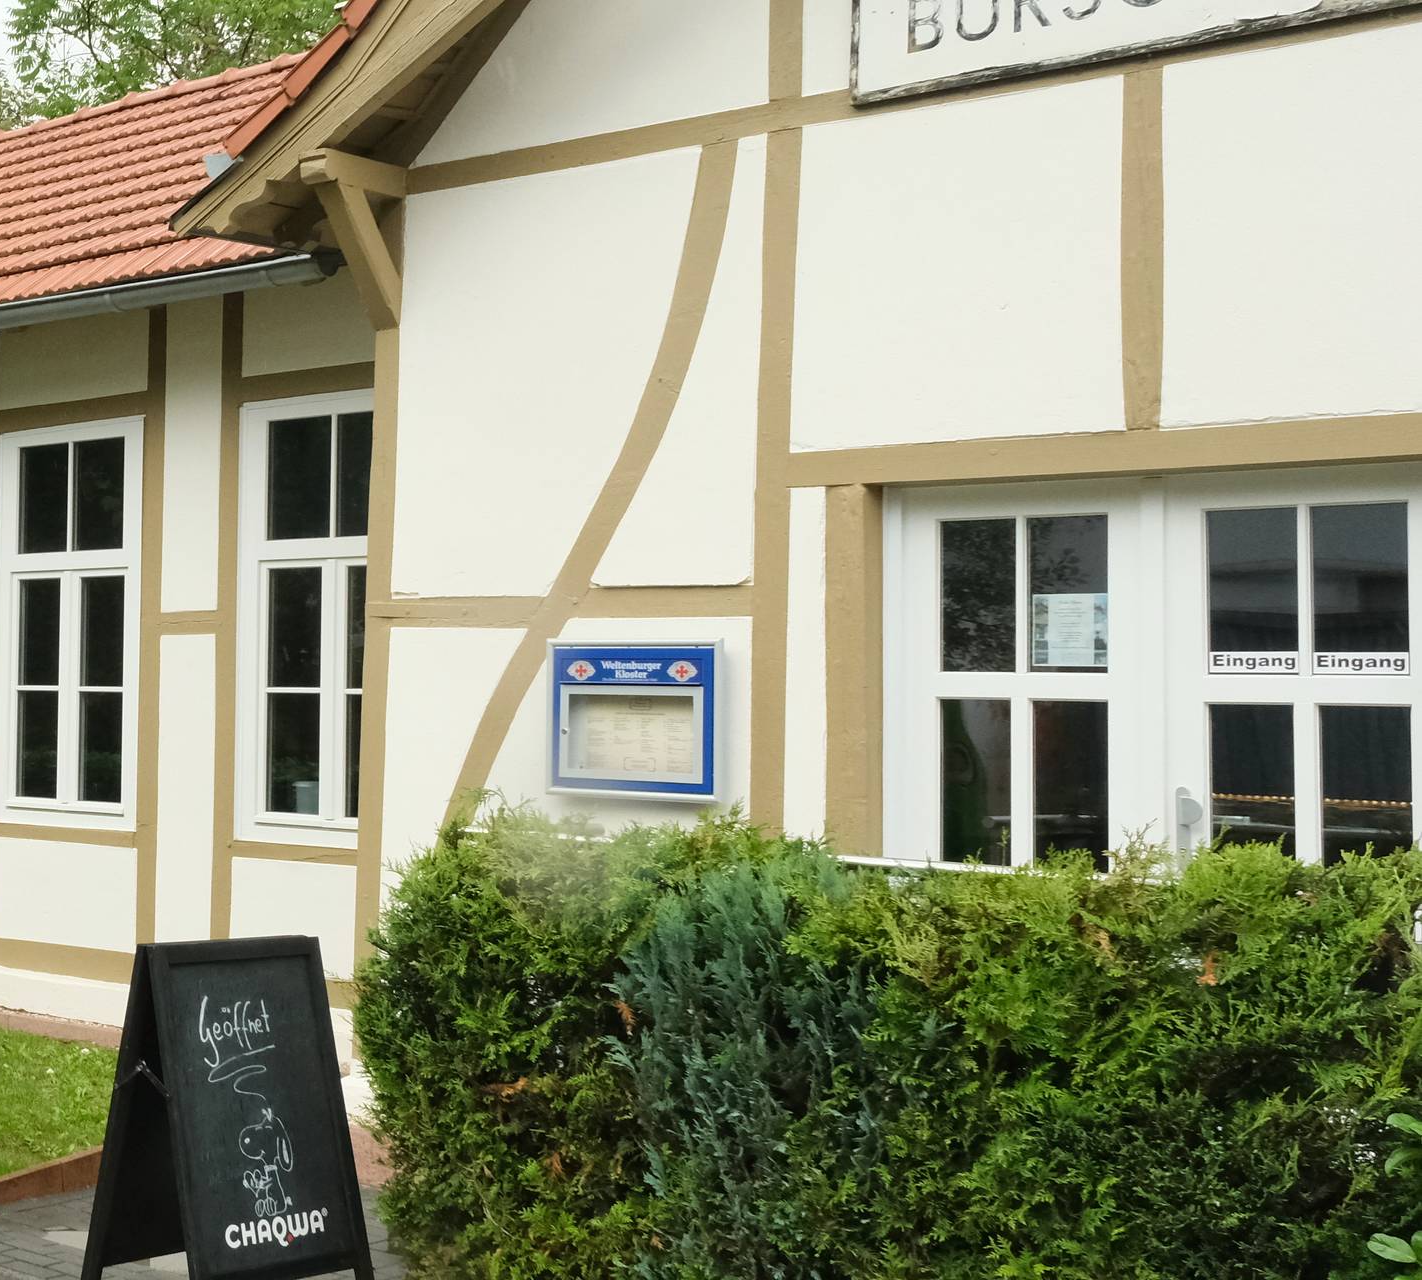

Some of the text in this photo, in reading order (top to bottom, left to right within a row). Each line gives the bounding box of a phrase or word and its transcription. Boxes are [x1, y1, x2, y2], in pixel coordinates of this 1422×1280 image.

[601, 660, 662, 672] Weltenburger
[1212, 654, 1296, 670] Eingang
[1316, 655, 1406, 671] Eingang
[615, 670, 648, 679] Kloster
[199, 995, 271, 1067] Geöffnet
